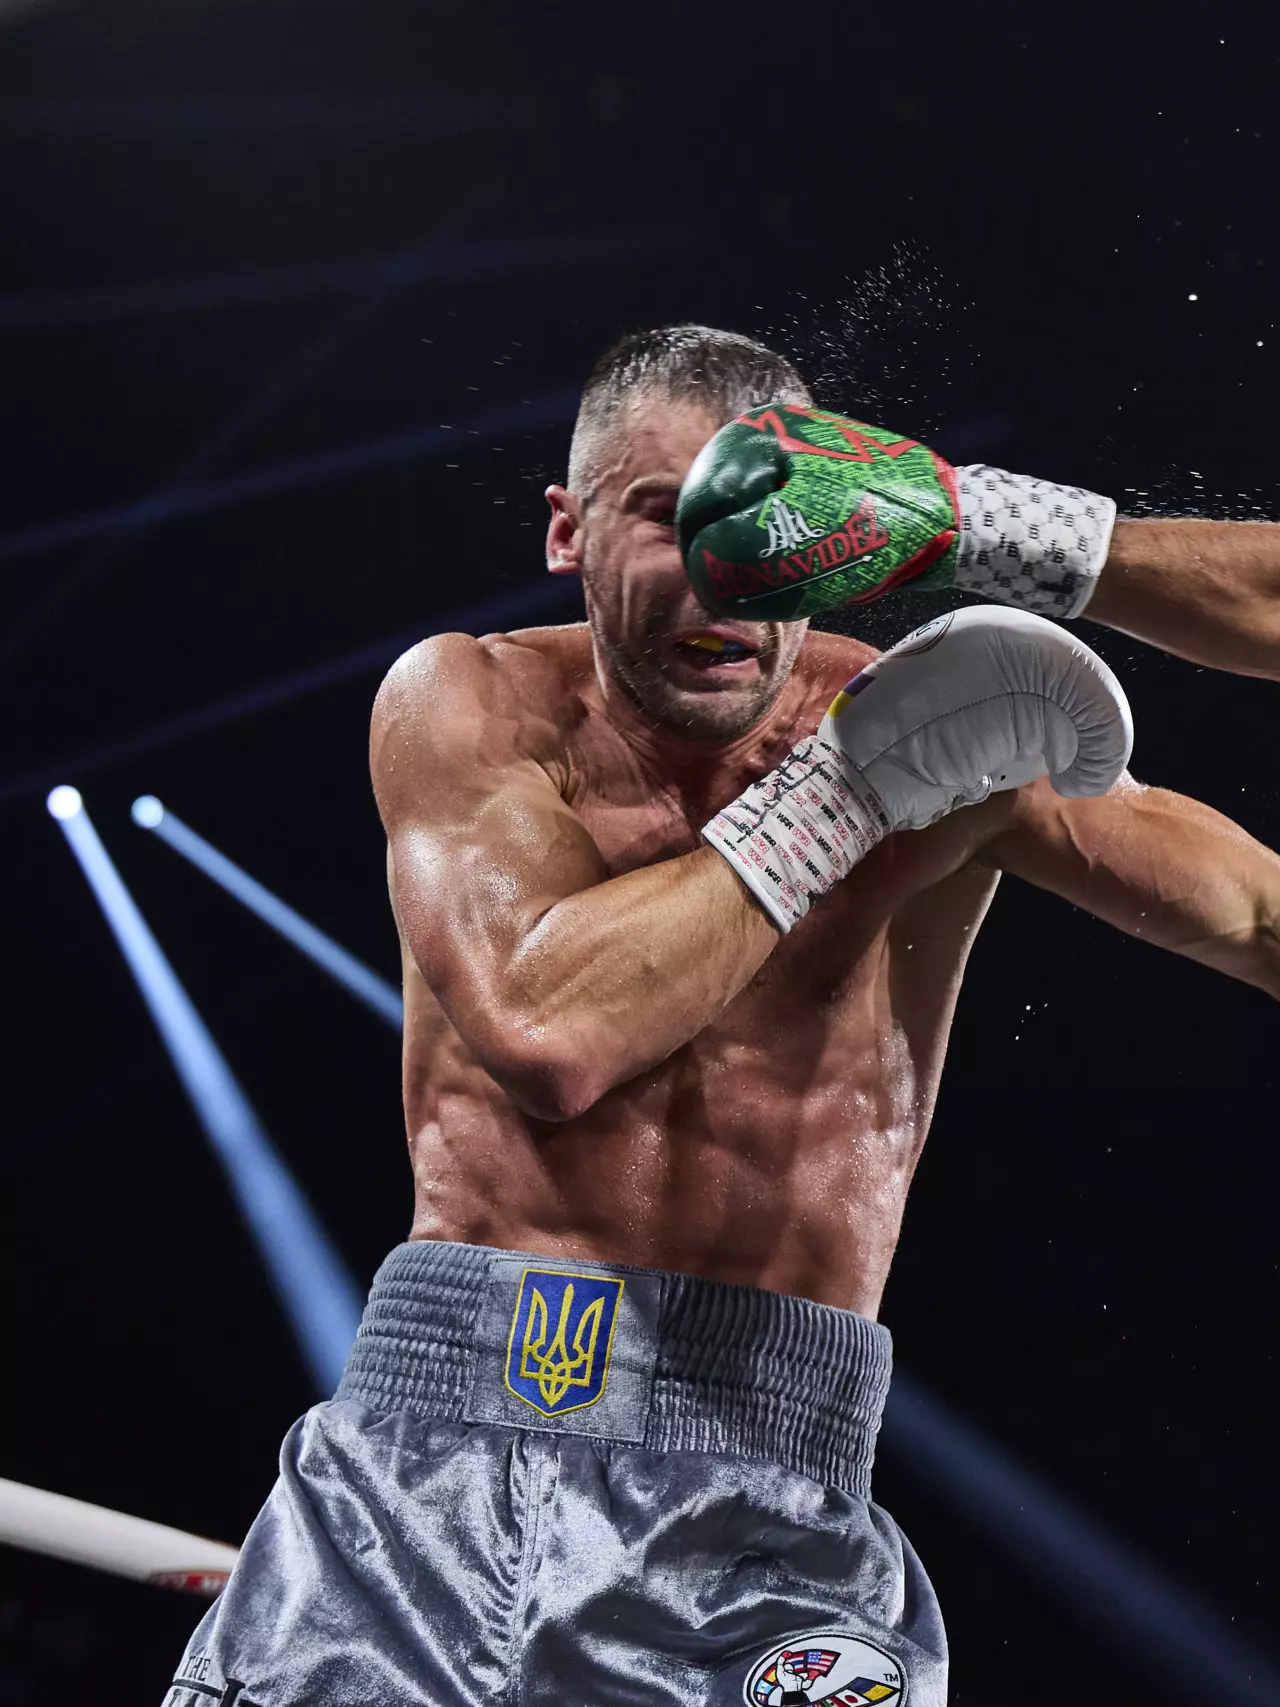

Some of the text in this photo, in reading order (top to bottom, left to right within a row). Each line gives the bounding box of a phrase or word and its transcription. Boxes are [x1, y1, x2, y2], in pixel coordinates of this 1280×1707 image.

[777, 813, 794, 830] WAR
[764, 865, 782, 884] WAR
[805, 859, 821, 878] WAR
[182, 1655, 211, 1681] THE
[883, 1673, 899, 1682] TM
